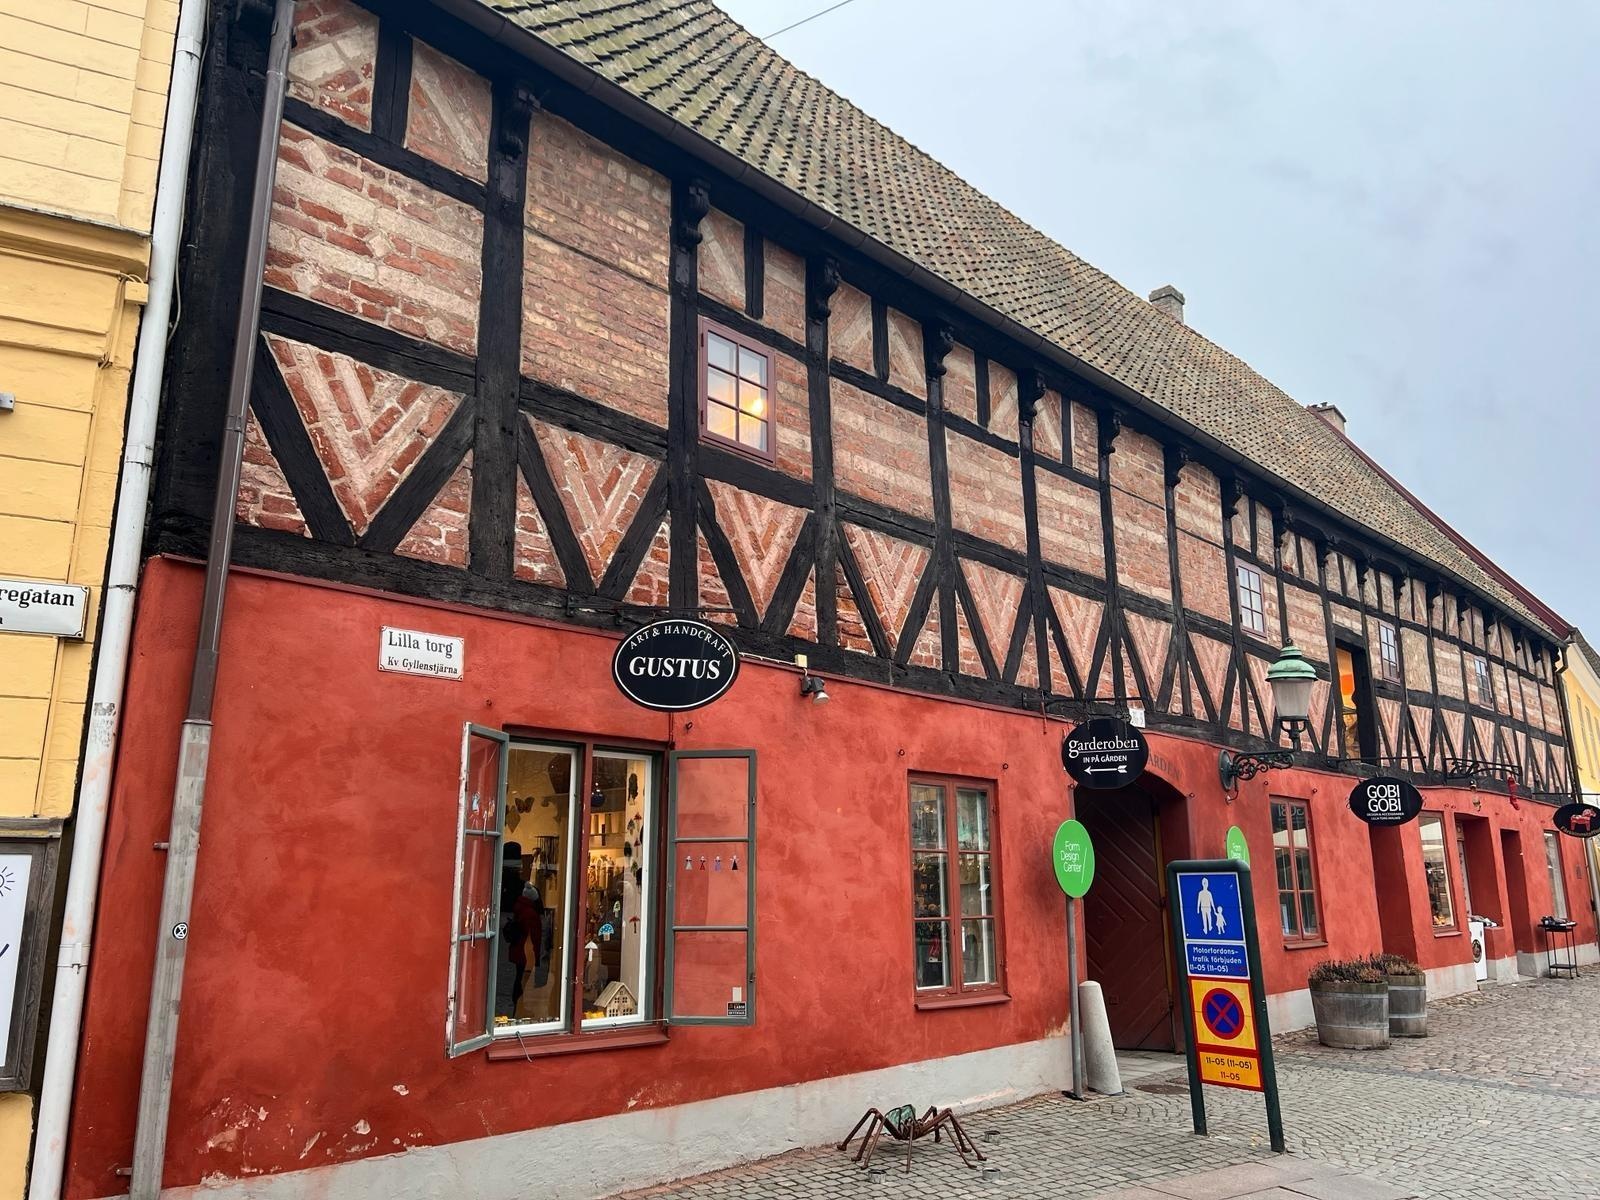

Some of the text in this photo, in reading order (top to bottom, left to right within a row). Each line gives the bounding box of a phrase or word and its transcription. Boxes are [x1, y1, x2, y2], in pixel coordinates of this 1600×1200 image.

[388, 630, 454, 659] Lilla torg
[629, 625, 731, 658] ART & HANDCRAFT
[387, 656, 458, 675] Kv Gyllenstjärna
[629, 656, 721, 680] GUSTUS
[1068, 735, 1140, 759] garderoben
[1091, 755, 1100, 763] PÅ
[1101, 754, 1128, 763] GÅRDEN
[1367, 784, 1400, 799] GOBI
[1368, 798, 1402, 812] GOBI
[1065, 840, 1081, 851] Form
[1061, 850, 1080, 863] Design
[1064, 862, 1082, 873] Center
[1192, 955, 1209, 963] trafik
[1206, 1056, 1252, 1070] 11-05 (11-05)
[1221, 1071, 1241, 1081] 11-05
